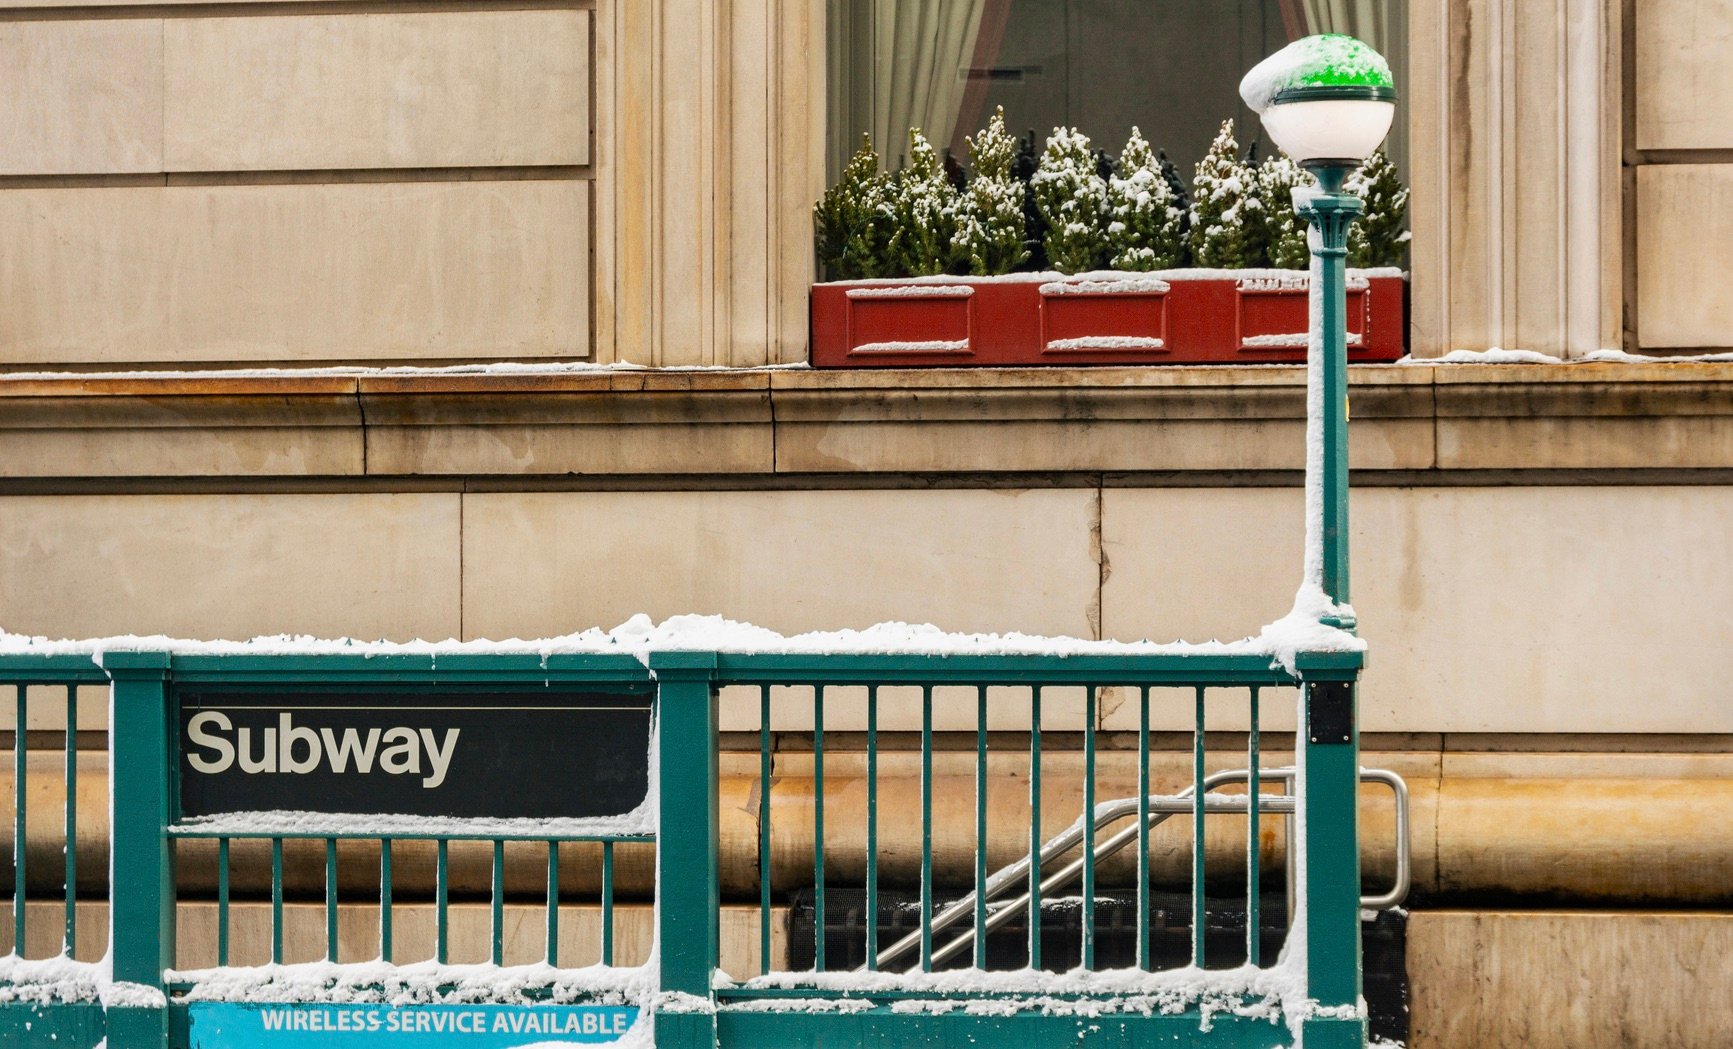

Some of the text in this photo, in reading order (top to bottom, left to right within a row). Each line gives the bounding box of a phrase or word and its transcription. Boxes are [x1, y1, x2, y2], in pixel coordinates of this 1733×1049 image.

[187, 711, 460, 788] Subway
[261, 1009, 627, 1035] WIRELESS SERVICE AVAILABLE
